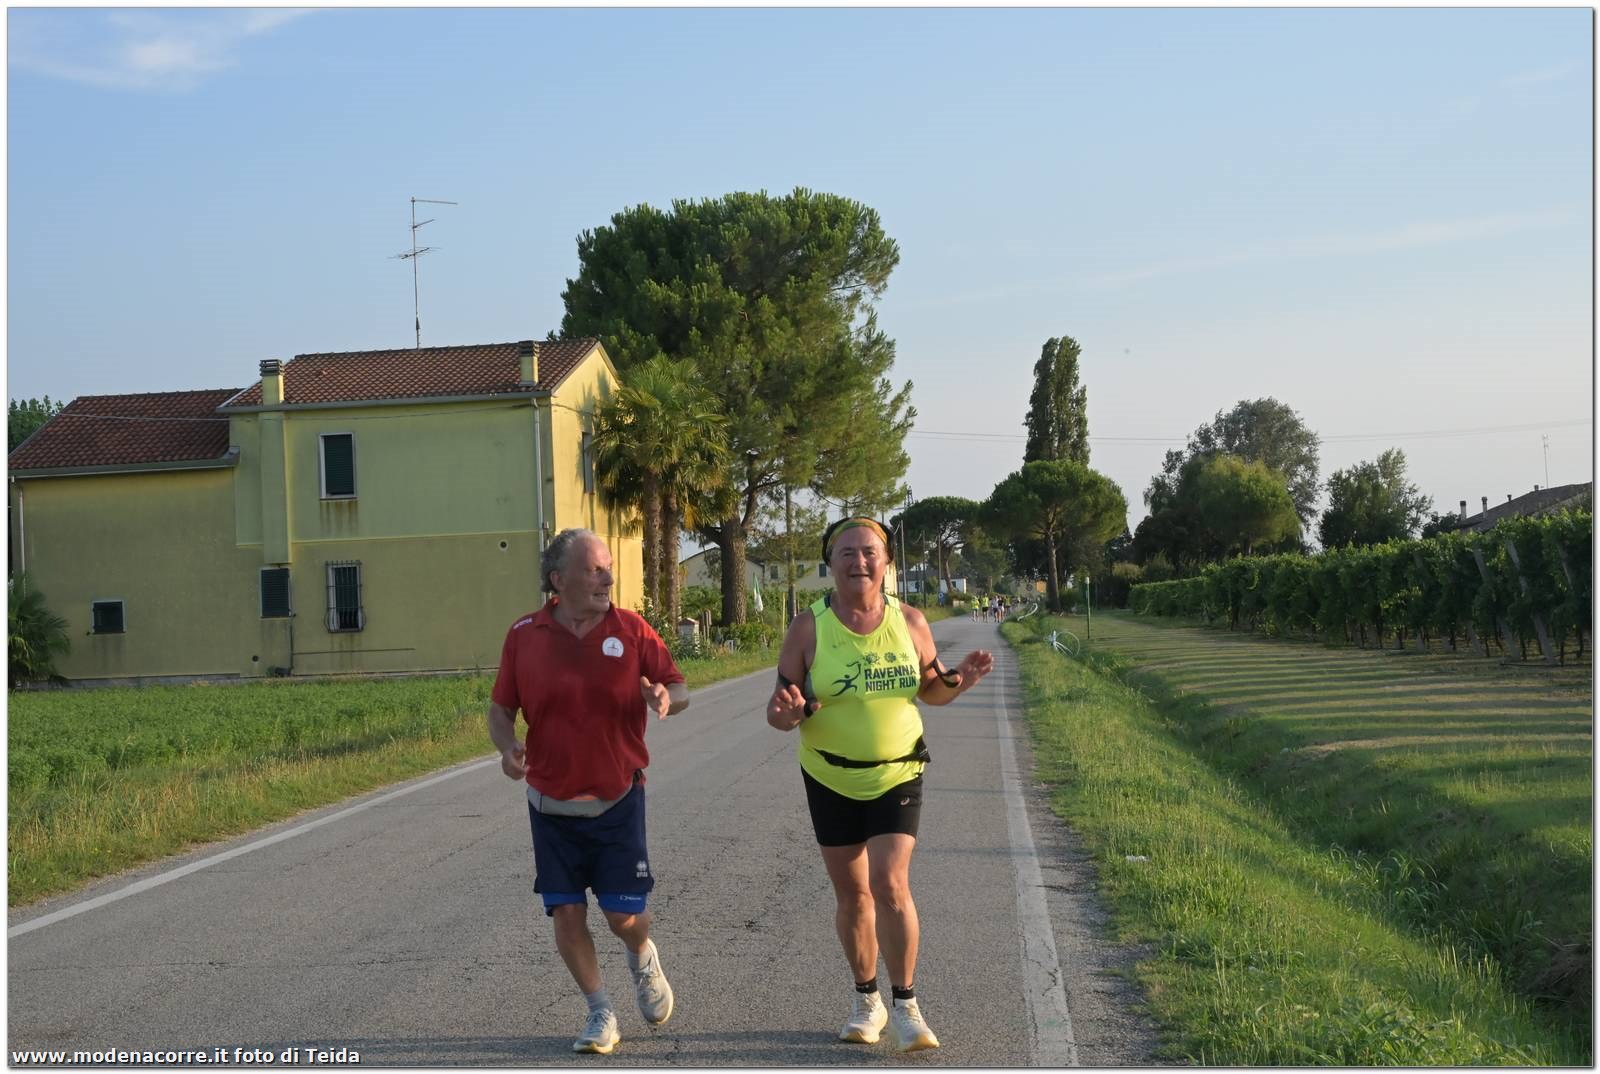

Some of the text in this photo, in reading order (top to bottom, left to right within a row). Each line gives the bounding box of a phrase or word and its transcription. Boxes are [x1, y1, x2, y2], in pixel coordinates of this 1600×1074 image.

[864, 664, 917, 680] RAVENNA
[865, 675, 917, 692] NIGHT RUN
